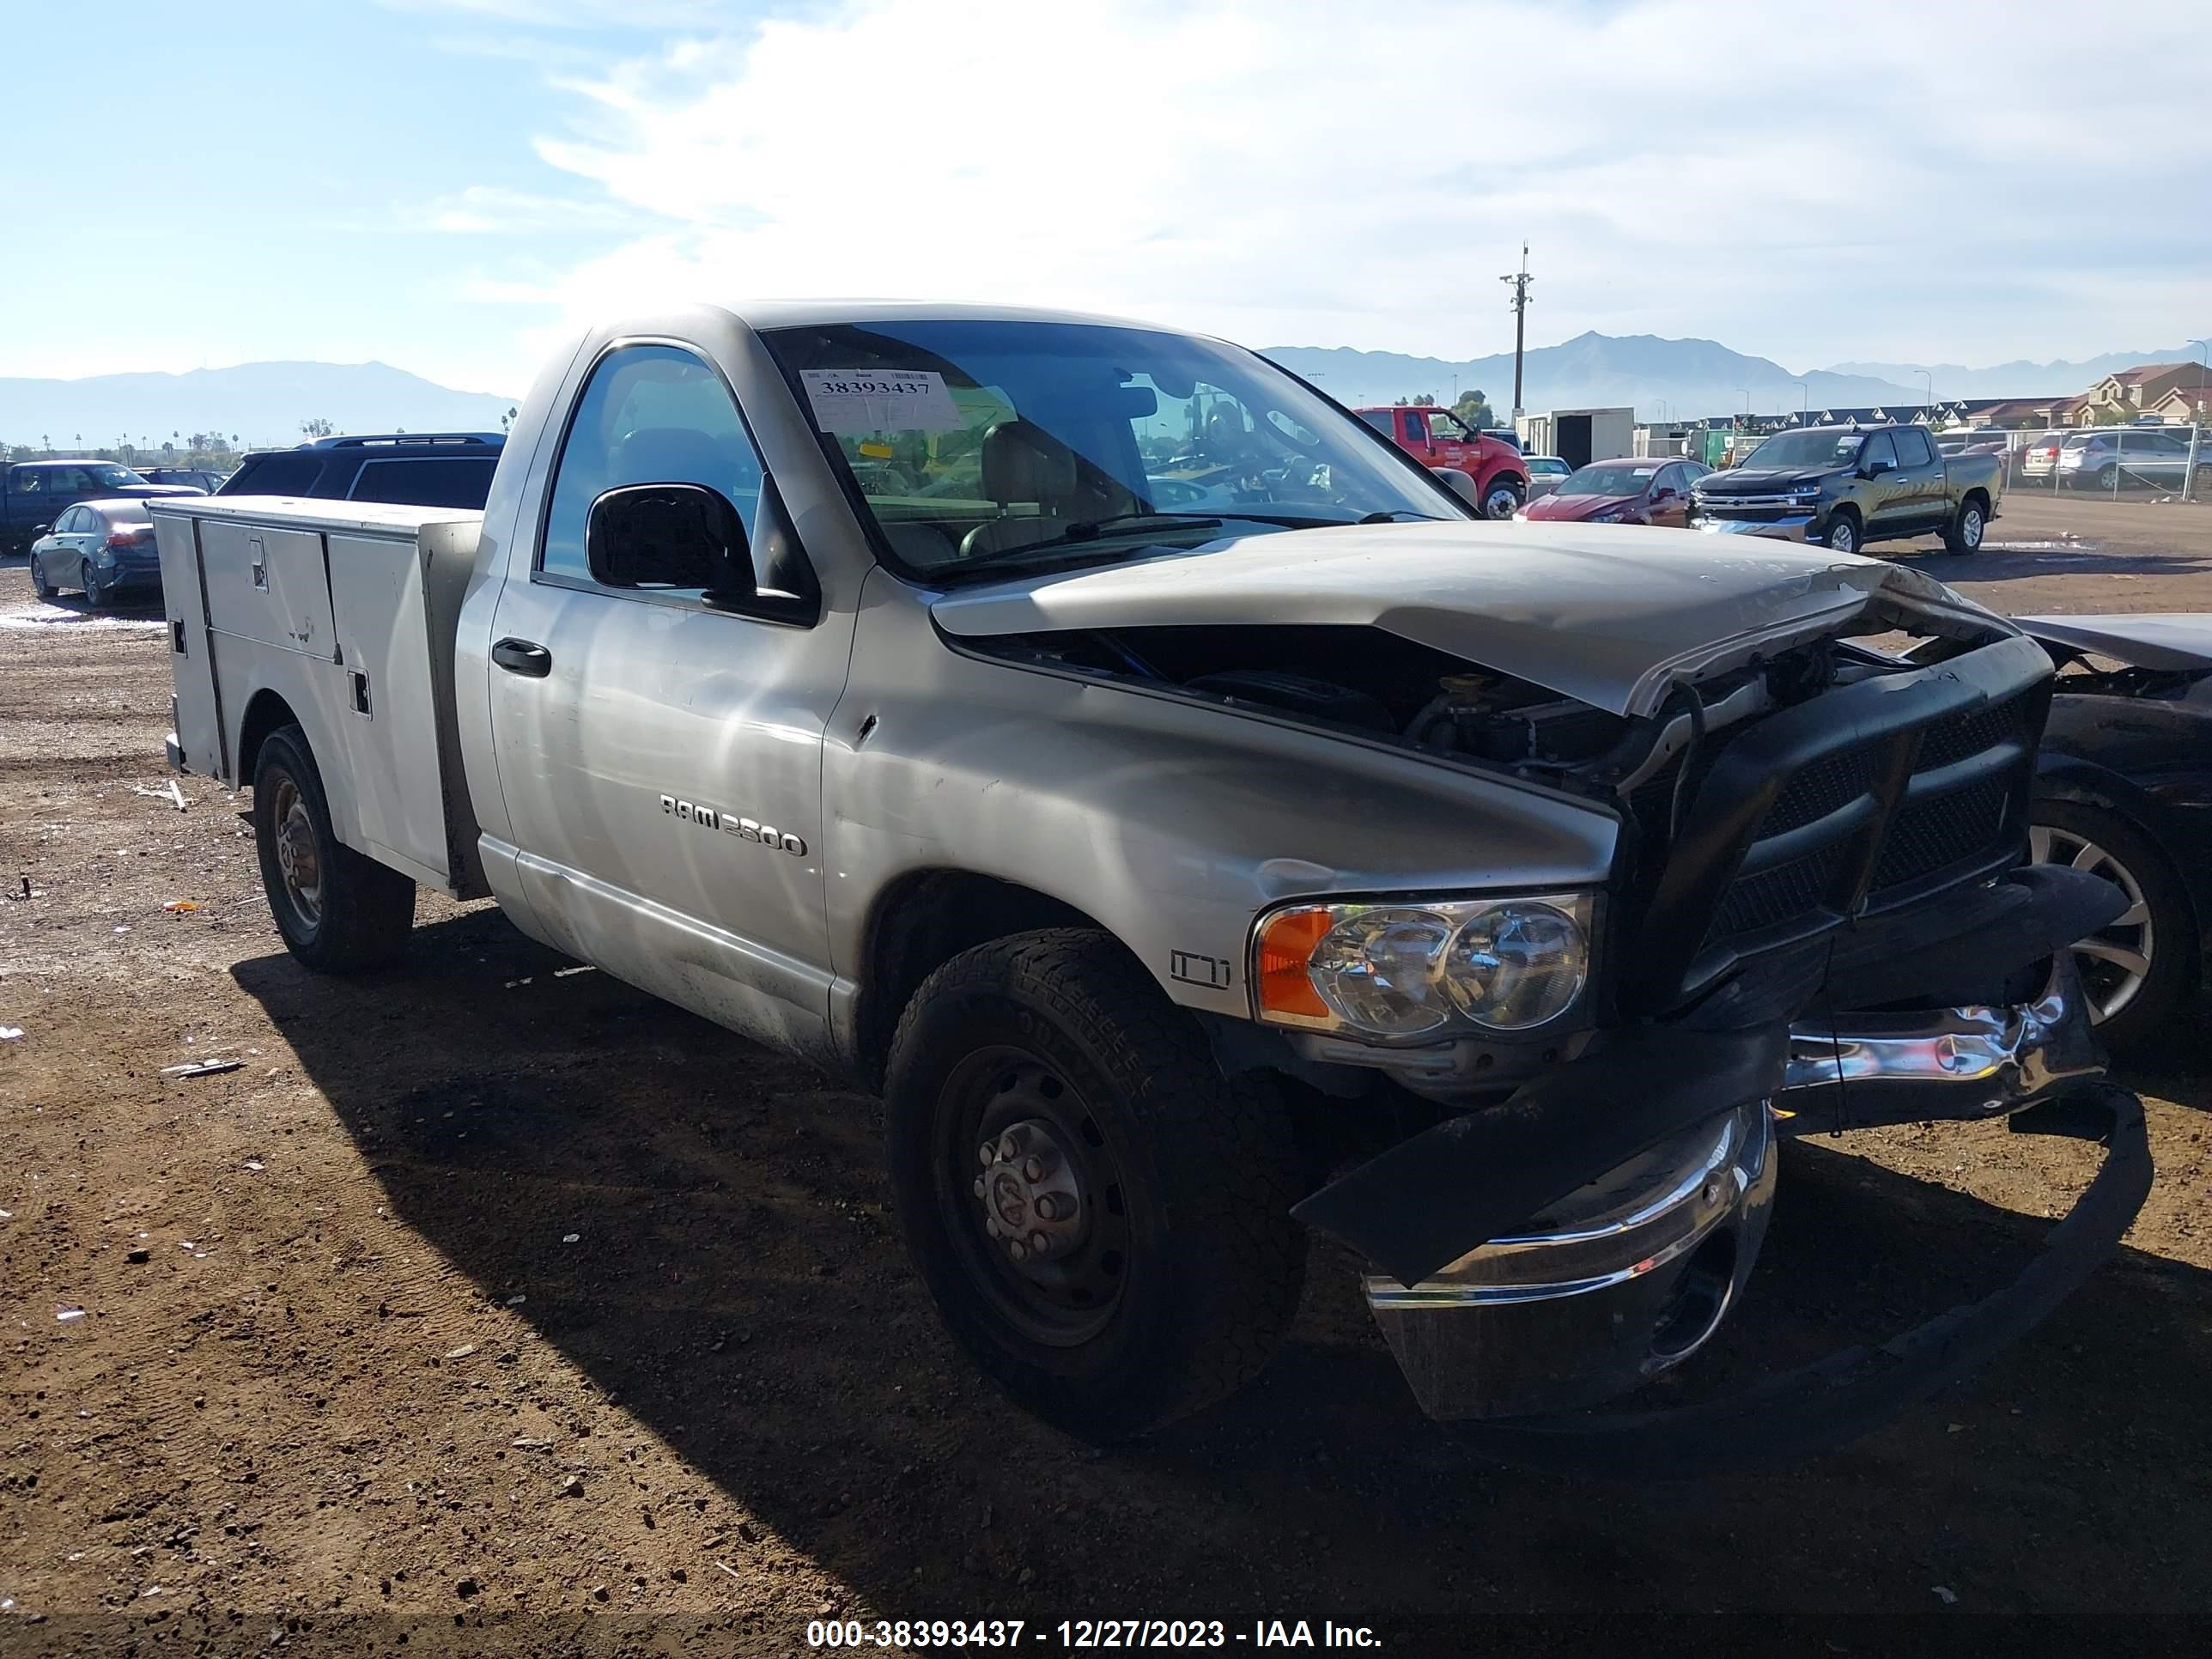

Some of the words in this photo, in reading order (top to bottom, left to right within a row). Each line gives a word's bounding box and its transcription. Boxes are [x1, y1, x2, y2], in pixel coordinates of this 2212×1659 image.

[821, 382, 930, 395] 38393437
[659, 793, 720, 830] RAM
[721, 813, 809, 857] 2500
